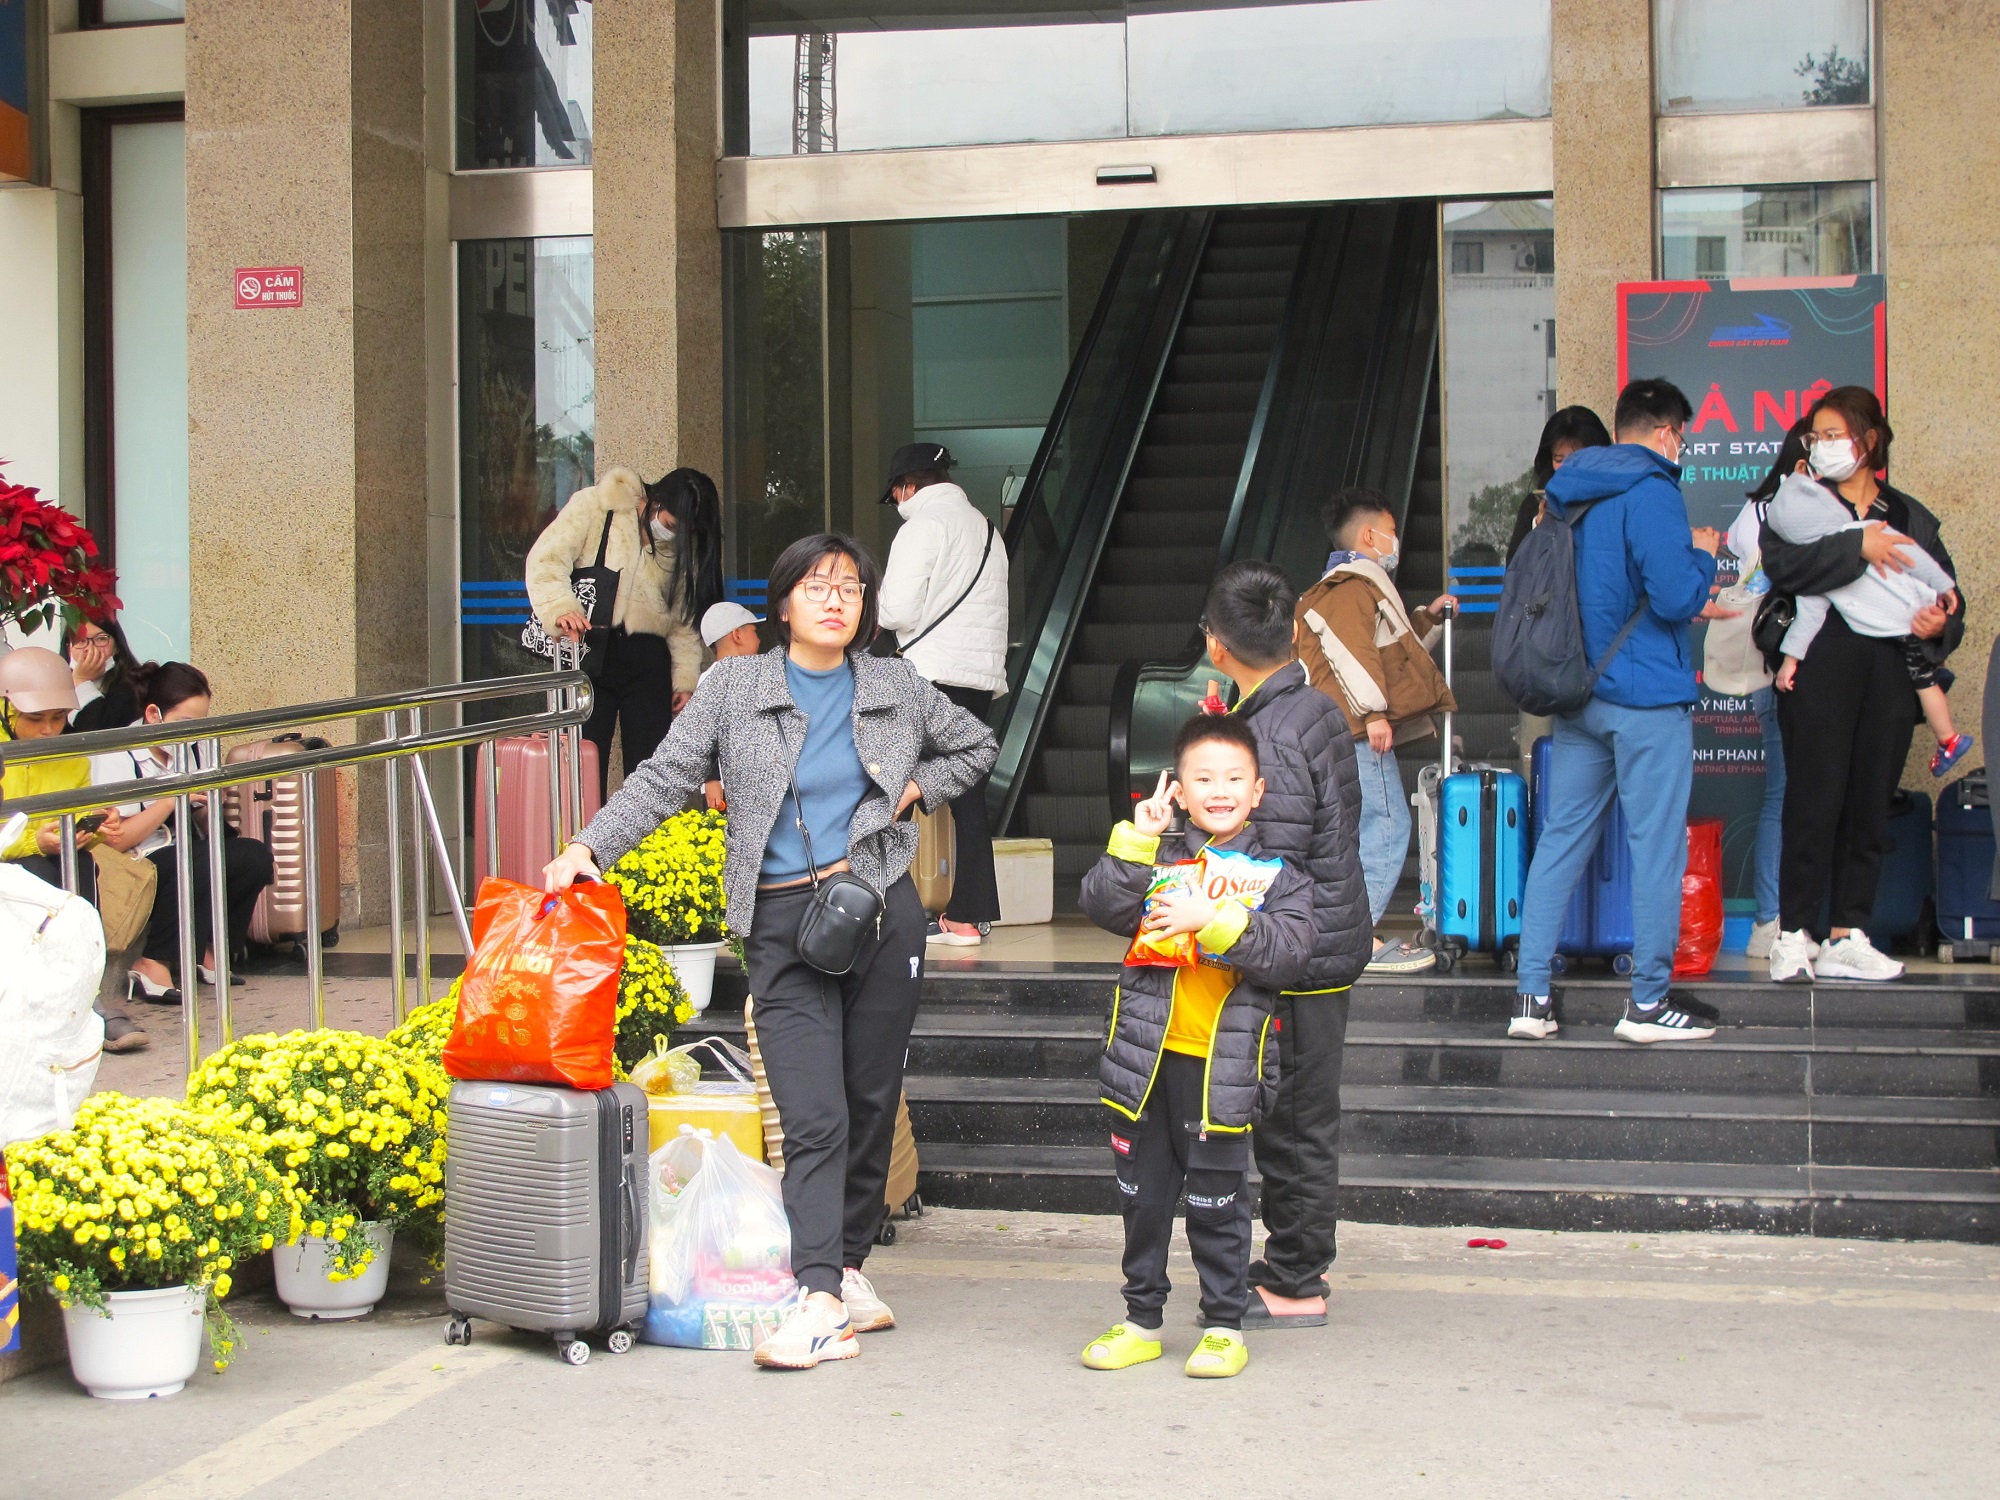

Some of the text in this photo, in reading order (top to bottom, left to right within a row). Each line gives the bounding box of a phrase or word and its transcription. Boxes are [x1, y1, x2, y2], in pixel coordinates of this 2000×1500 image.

[265, 272, 294, 287] CẤM
[262, 288, 297, 301] HÚT THUỐC
[1701, 463, 1761, 484] THUẬT
[1713, 696, 1746, 713] NIỆM
[1714, 726, 1742, 734] TRINH
[1717, 749, 1757, 761] PHAN
[1727, 765, 1739, 773] BY
[1199, 957, 1231, 971] FASHION
[1390, 962, 1418, 970] crocs
